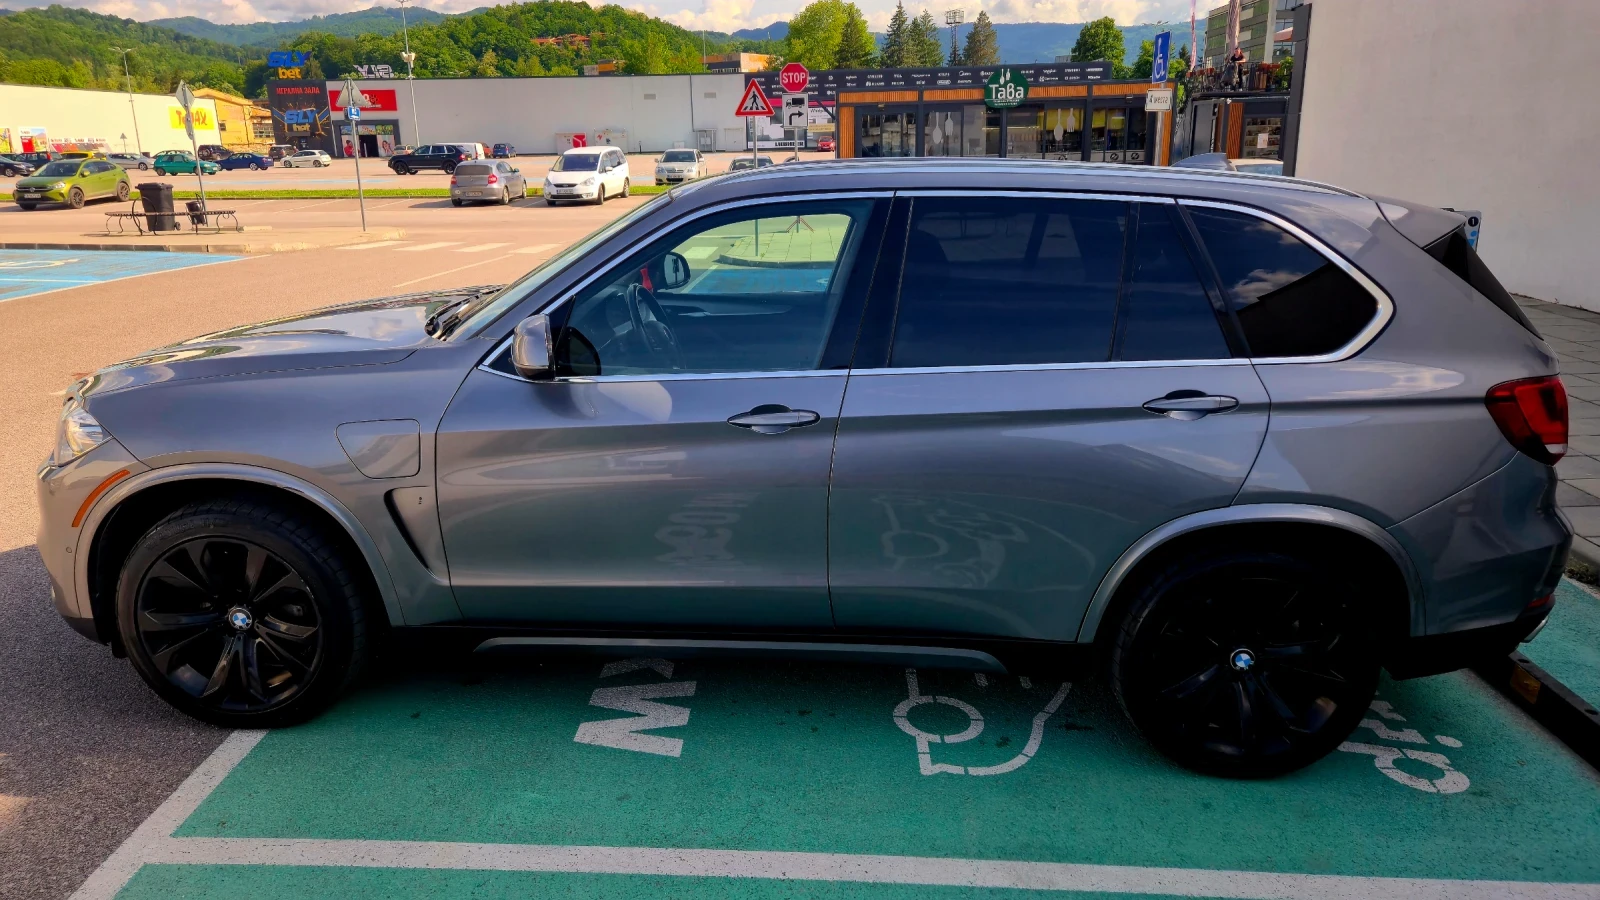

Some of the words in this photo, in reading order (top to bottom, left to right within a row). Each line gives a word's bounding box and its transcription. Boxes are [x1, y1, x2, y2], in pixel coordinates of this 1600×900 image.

[268, 51, 312, 67] SLY
[278, 67, 301, 79] bet
[782, 72, 806, 84] STOP
[304, 86, 320, 94] ЗАЛА
[285, 109, 318, 124] SLY
